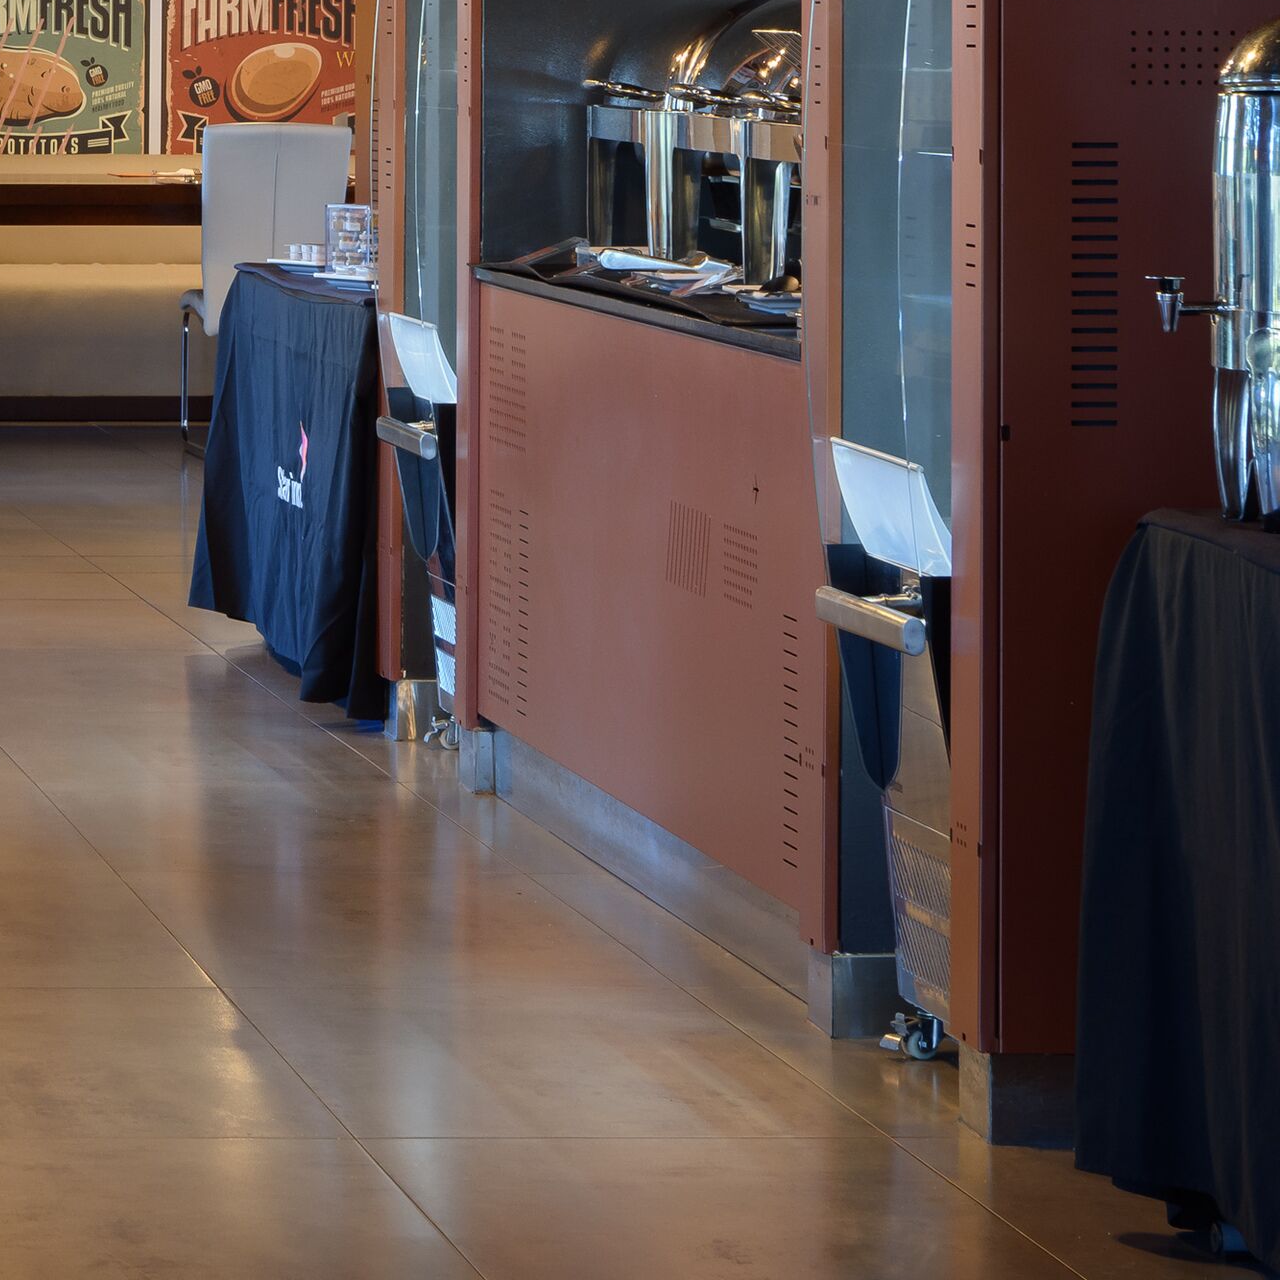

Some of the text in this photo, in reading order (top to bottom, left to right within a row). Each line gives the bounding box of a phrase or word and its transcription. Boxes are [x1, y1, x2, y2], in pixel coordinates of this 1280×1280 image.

[89, 66, 103, 78] GMO
[92, 86, 115, 98] PREMIUM
[194, 78, 212, 95] GMO
[321, 86, 344, 97] PREMIUM
[198, 91, 217, 105] FREE
